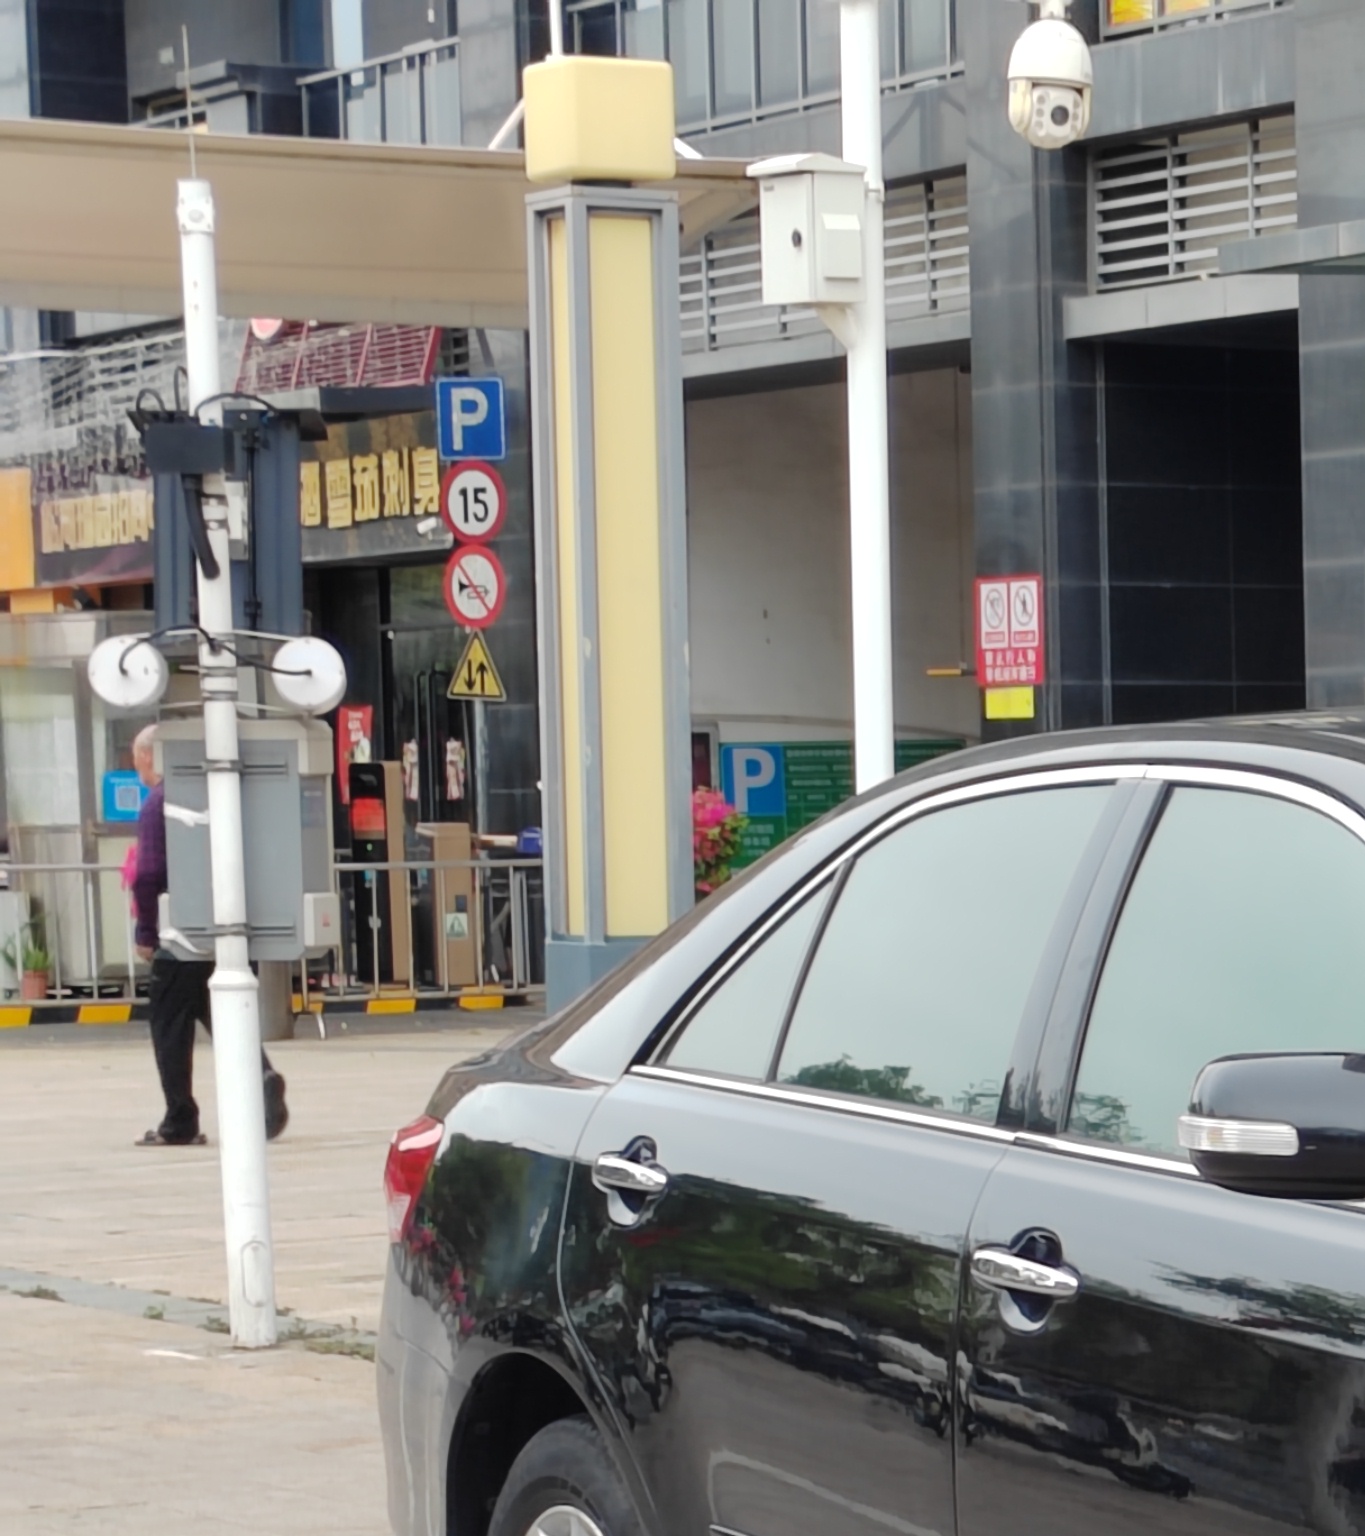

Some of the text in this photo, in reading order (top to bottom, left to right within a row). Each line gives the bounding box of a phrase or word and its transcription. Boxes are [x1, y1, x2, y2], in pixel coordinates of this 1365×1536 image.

[450, 387, 489, 450] P
[458, 486, 490, 525] 15
[731, 747, 776, 814] P
